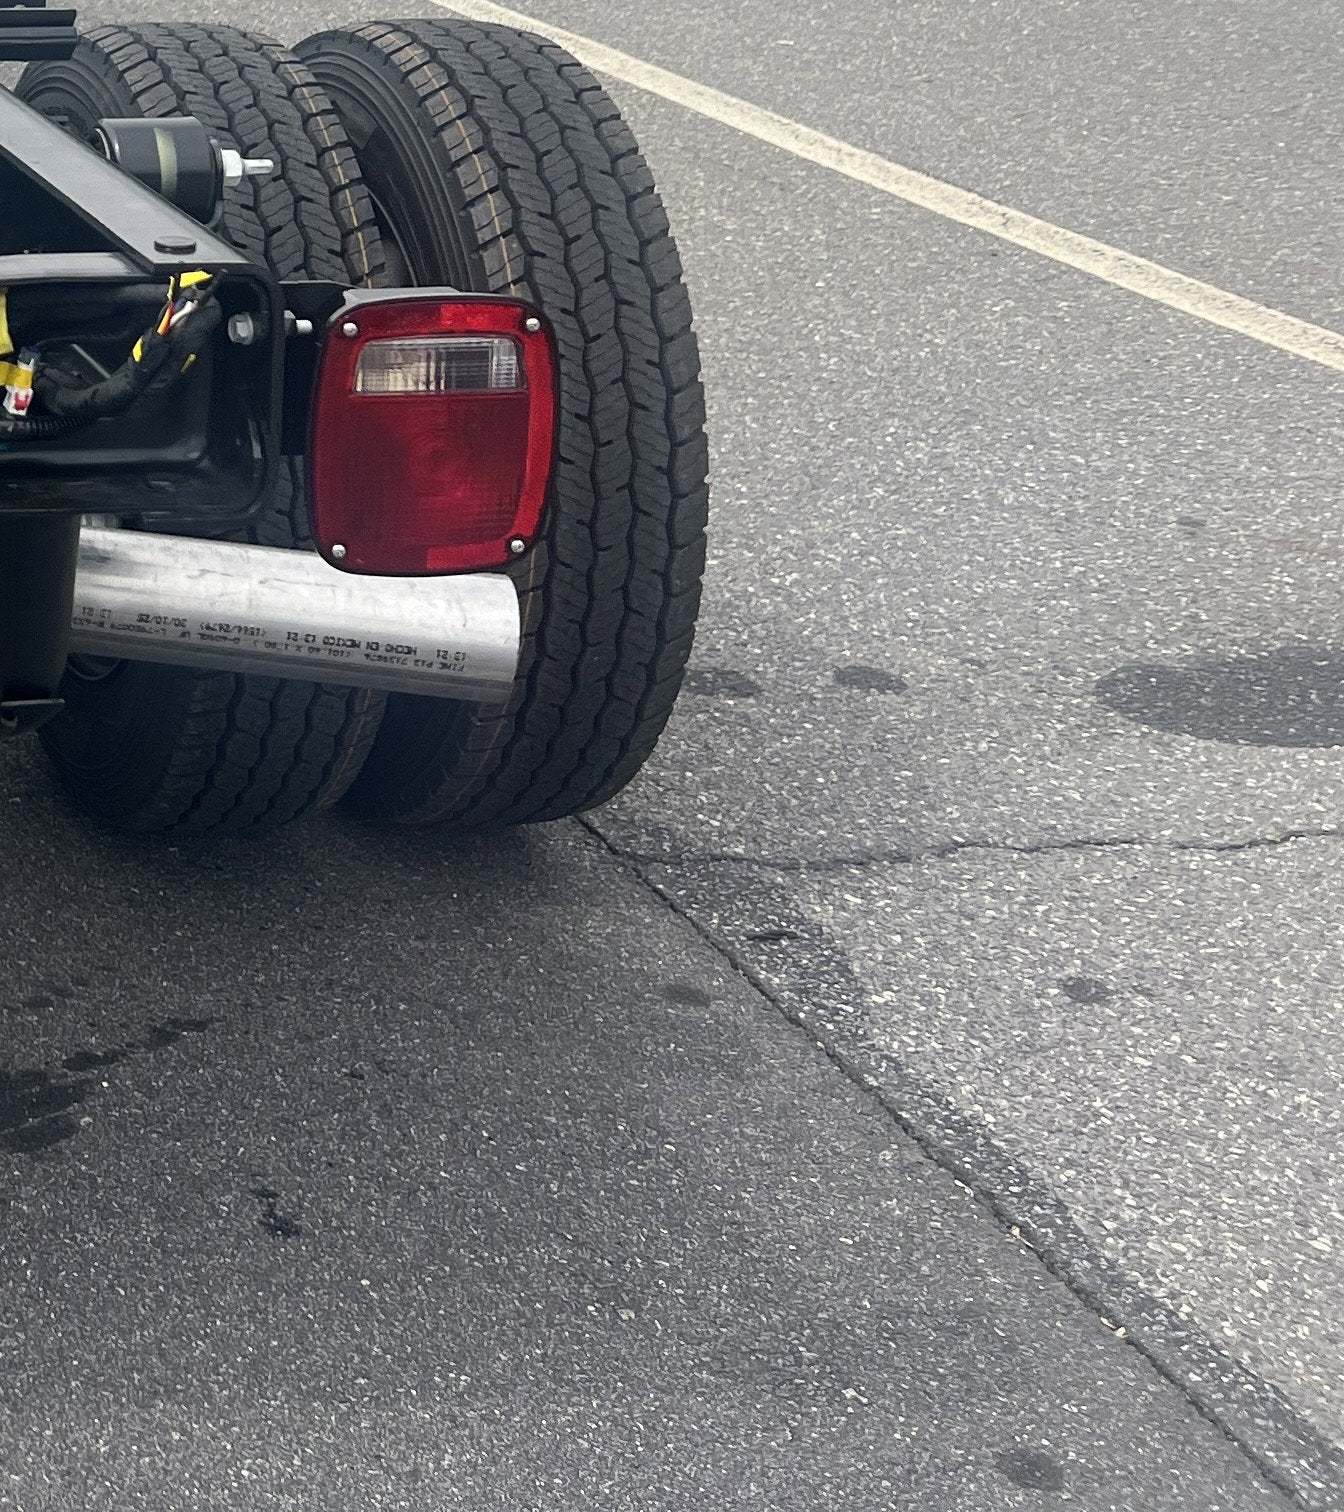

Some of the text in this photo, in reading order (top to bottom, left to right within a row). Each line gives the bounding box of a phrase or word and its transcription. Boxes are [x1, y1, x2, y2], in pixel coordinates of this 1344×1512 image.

[323, 636, 361, 649] MEXICO
[366, 641, 379, 651] EN
[384, 643, 417, 656] HECHO
